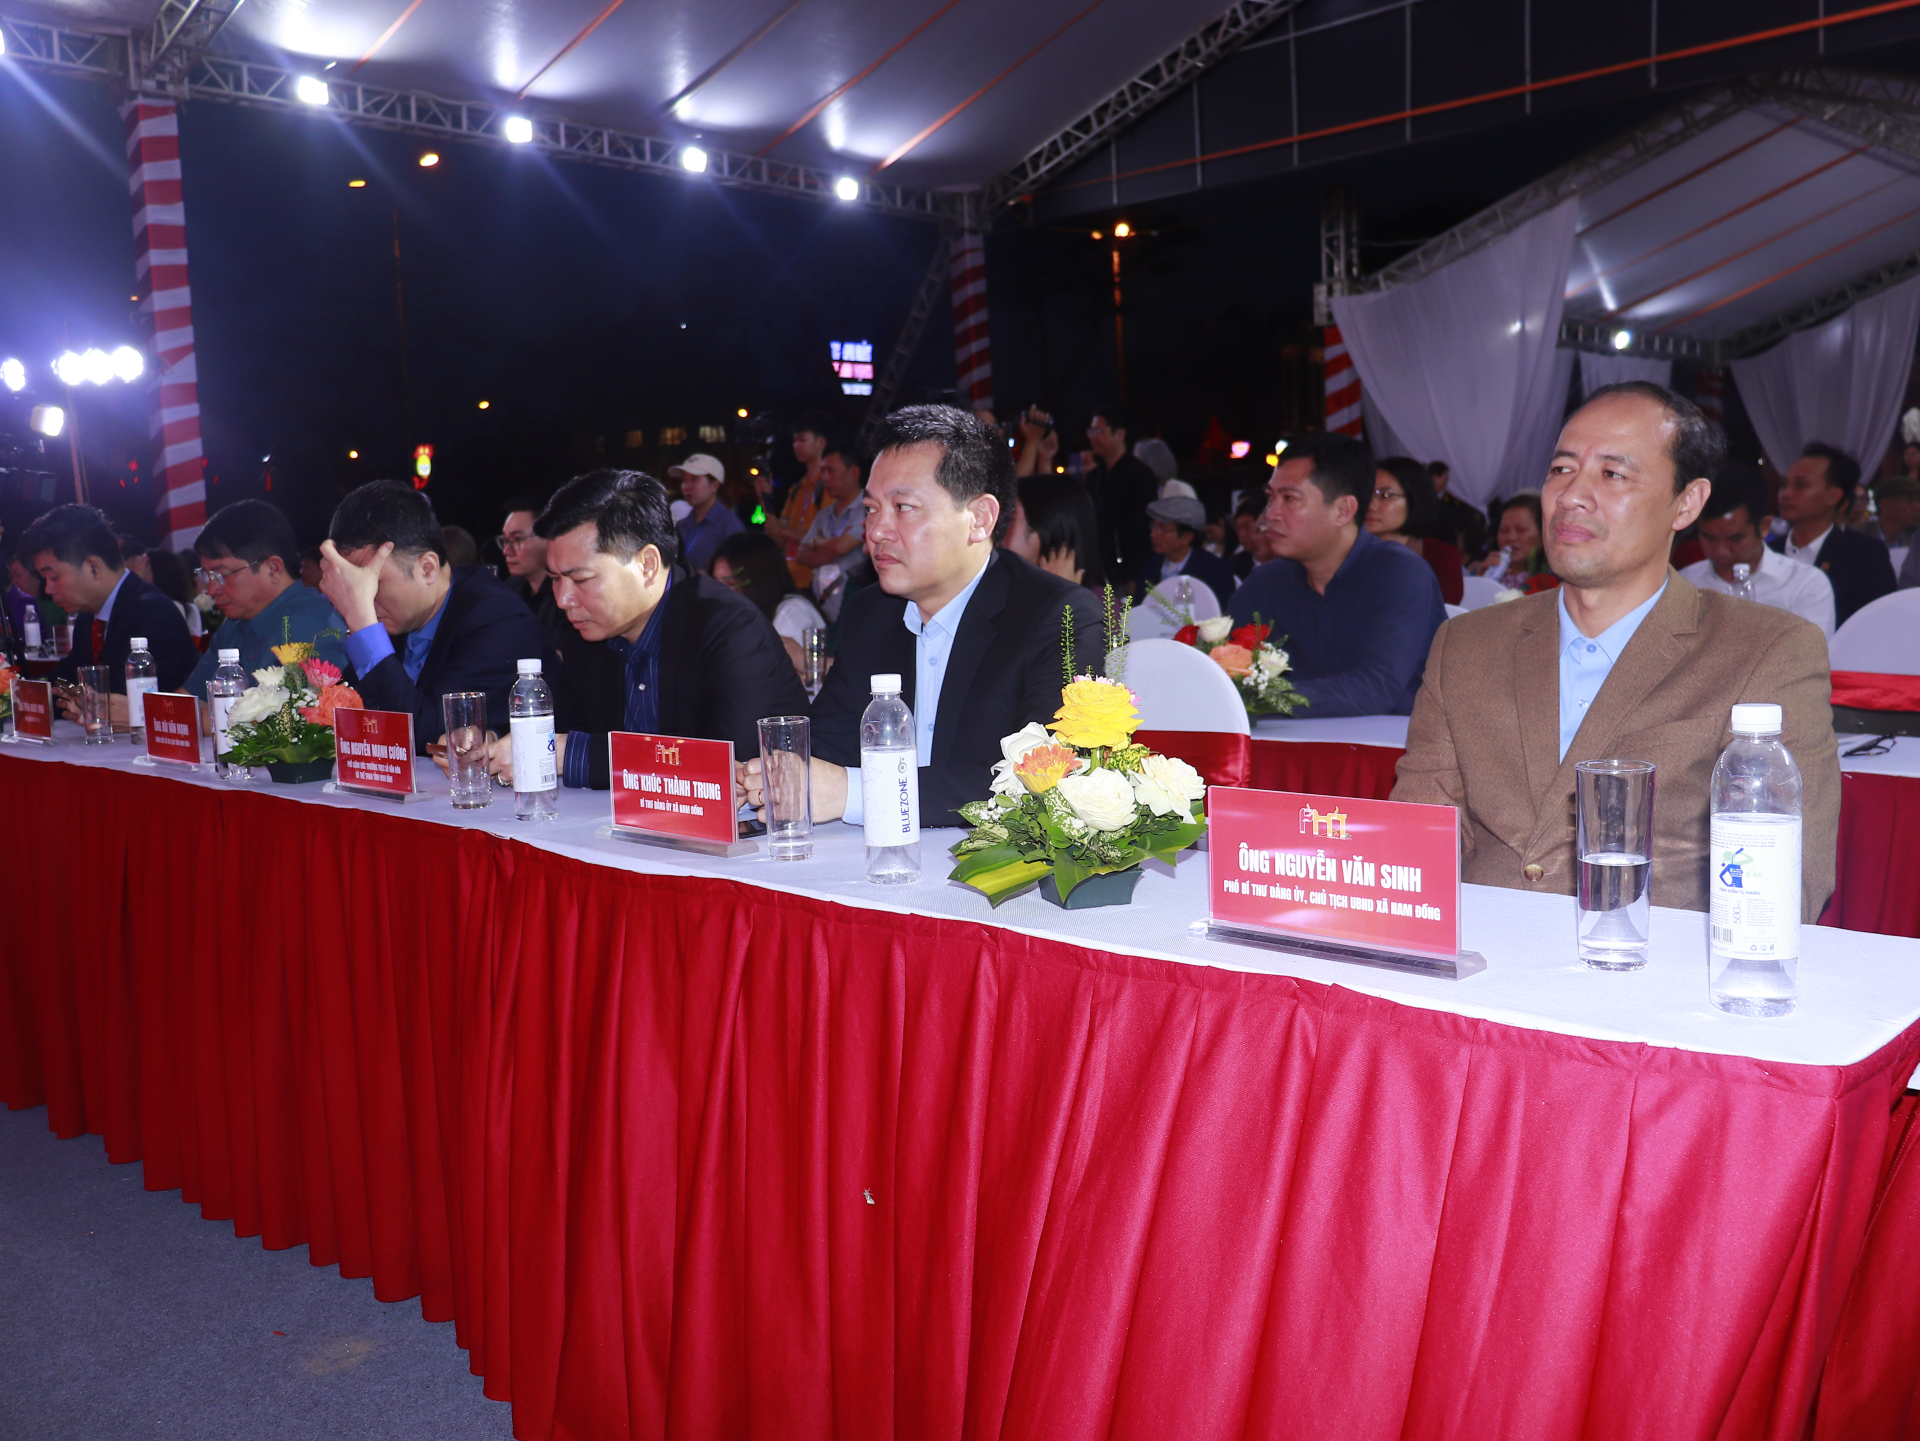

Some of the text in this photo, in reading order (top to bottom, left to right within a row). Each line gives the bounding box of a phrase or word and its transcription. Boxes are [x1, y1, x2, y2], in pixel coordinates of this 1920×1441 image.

[622, 768, 721, 801] ÔNG KHÚC THÀNH TRUNG
[898, 776, 911, 834] BLUEZONE
[1239, 842, 1422, 892] ÔNG NGUYỄN VĂN SINH
[1224, 879, 1441, 921] PHÓ BÍ THƯ ĐẢNG ỦY, CHỦ TỊCH UBND XÃ NAM ĐỐNG
[1733, 900, 1742, 925] 500ml
